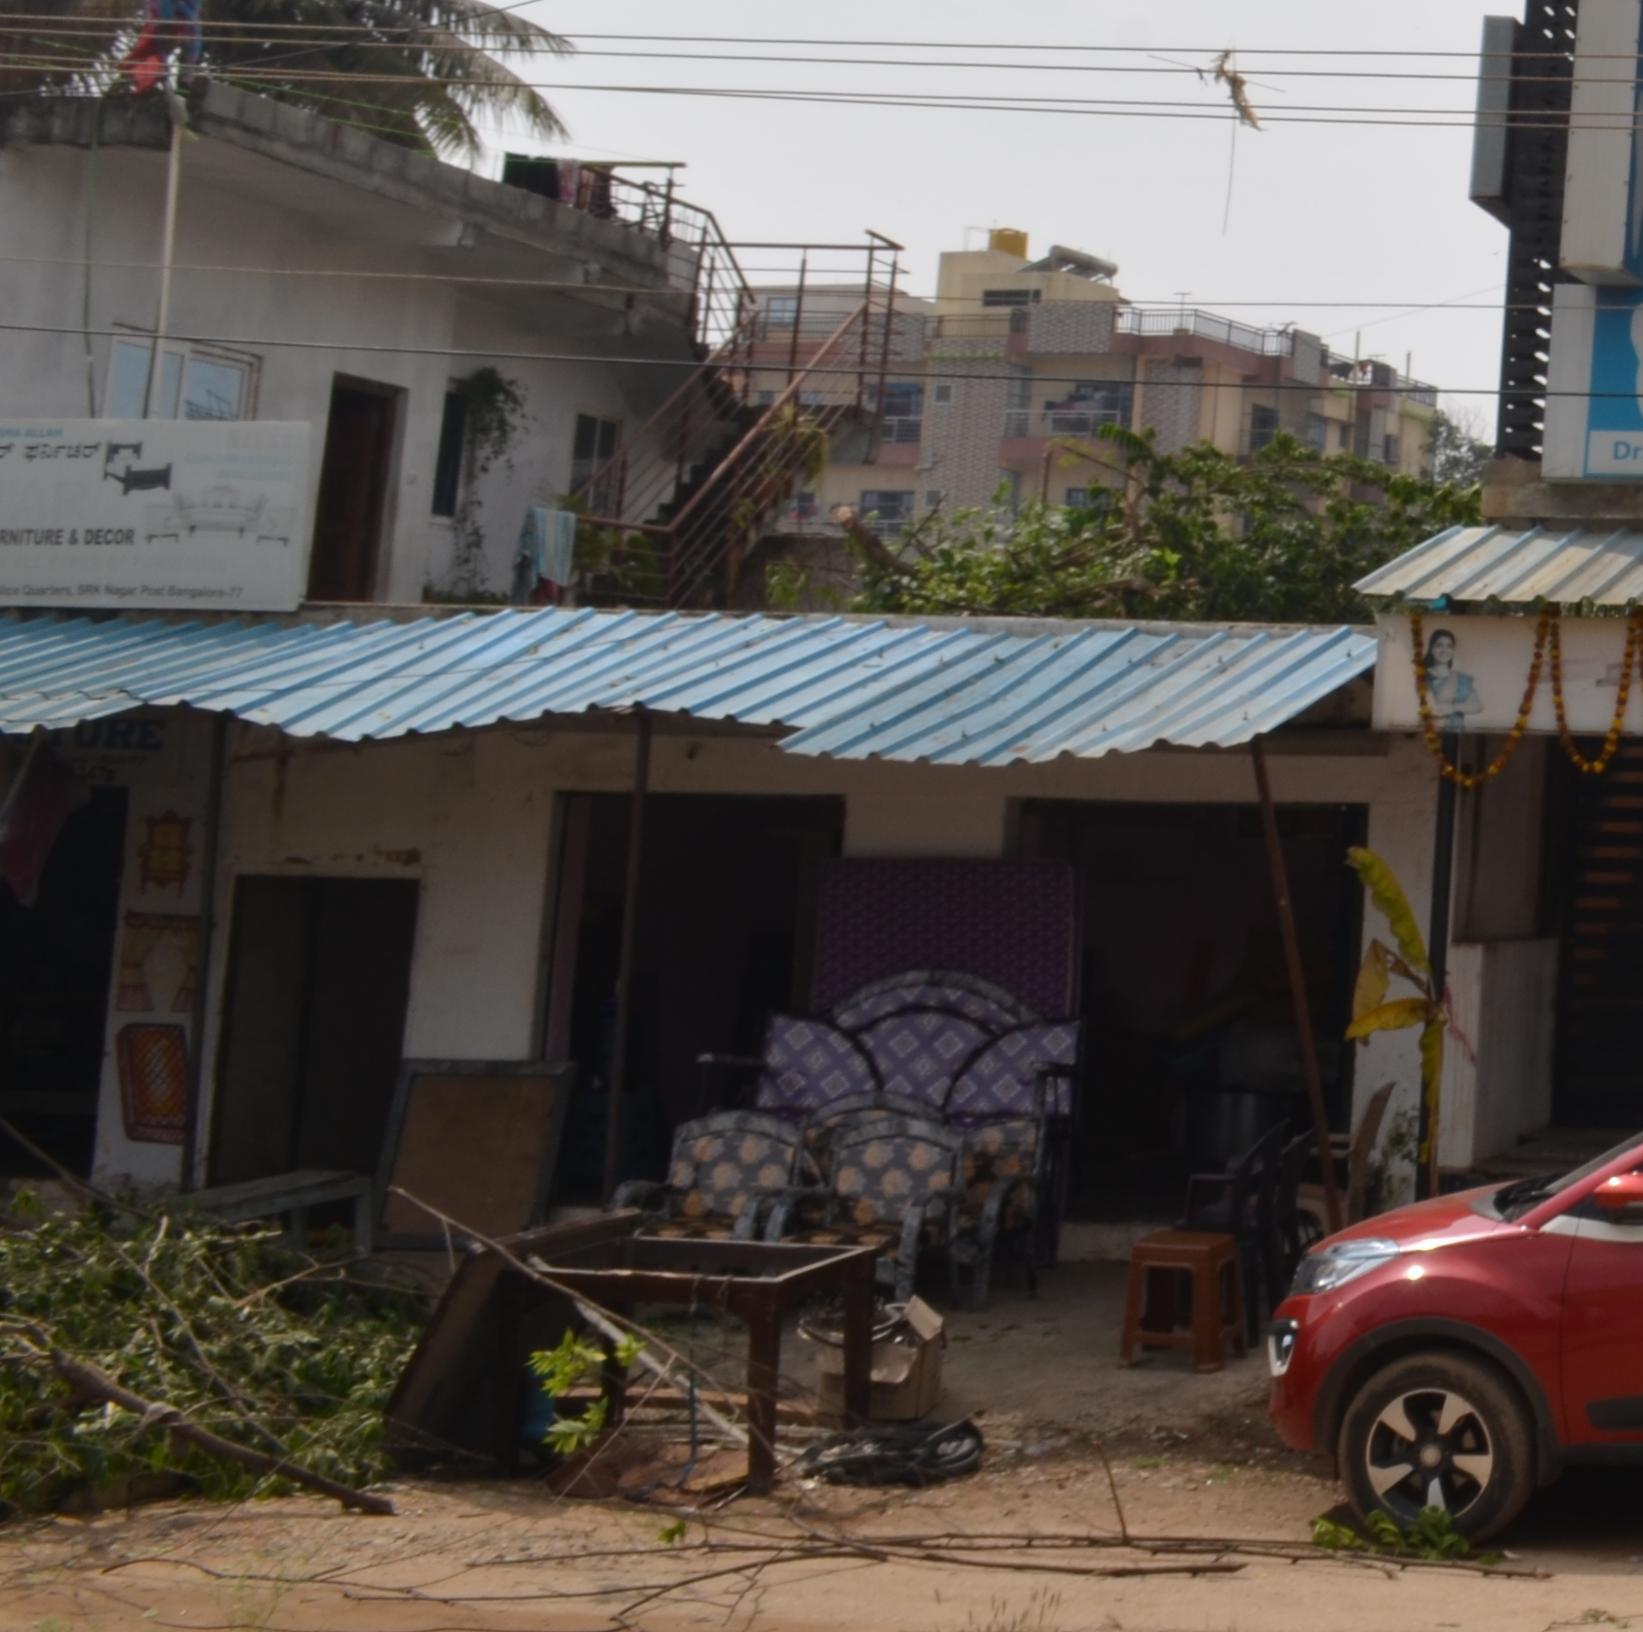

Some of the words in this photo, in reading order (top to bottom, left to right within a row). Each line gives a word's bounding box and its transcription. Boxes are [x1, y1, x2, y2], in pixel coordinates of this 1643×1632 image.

[68, 529, 79, 546] &
[84, 529, 135, 546] DECOR
[104, 585, 138, 599] Nagar
